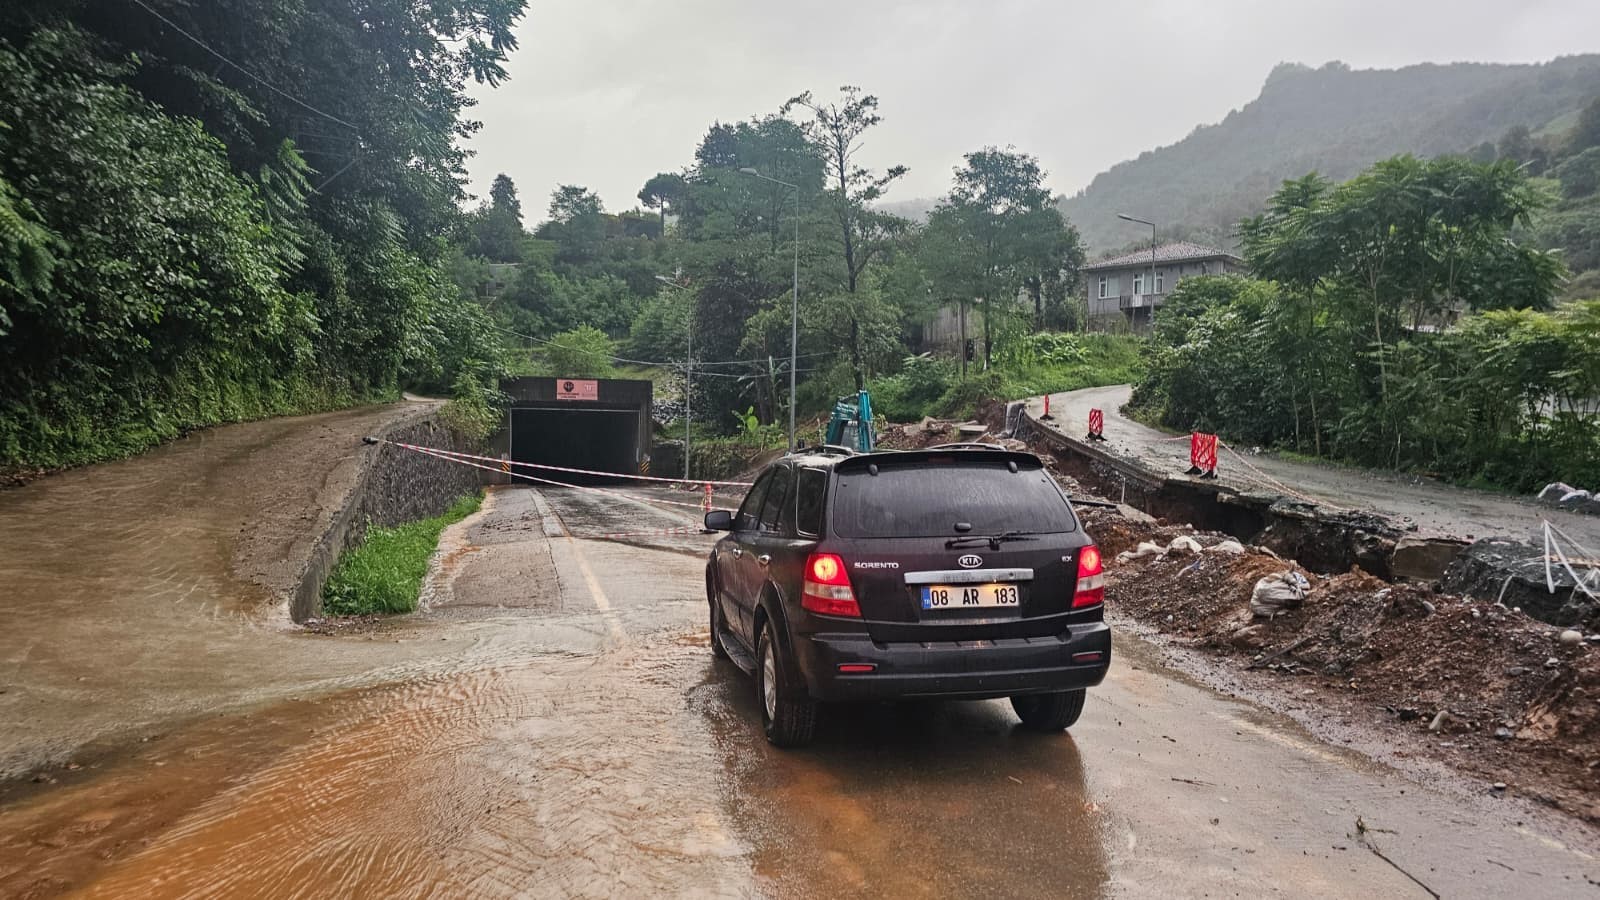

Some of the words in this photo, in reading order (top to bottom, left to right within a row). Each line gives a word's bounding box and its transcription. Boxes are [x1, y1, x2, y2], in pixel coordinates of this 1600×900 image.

[931, 590, 949, 606] 08
[962, 588, 980, 605] AR
[994, 587, 1017, 604] 183
